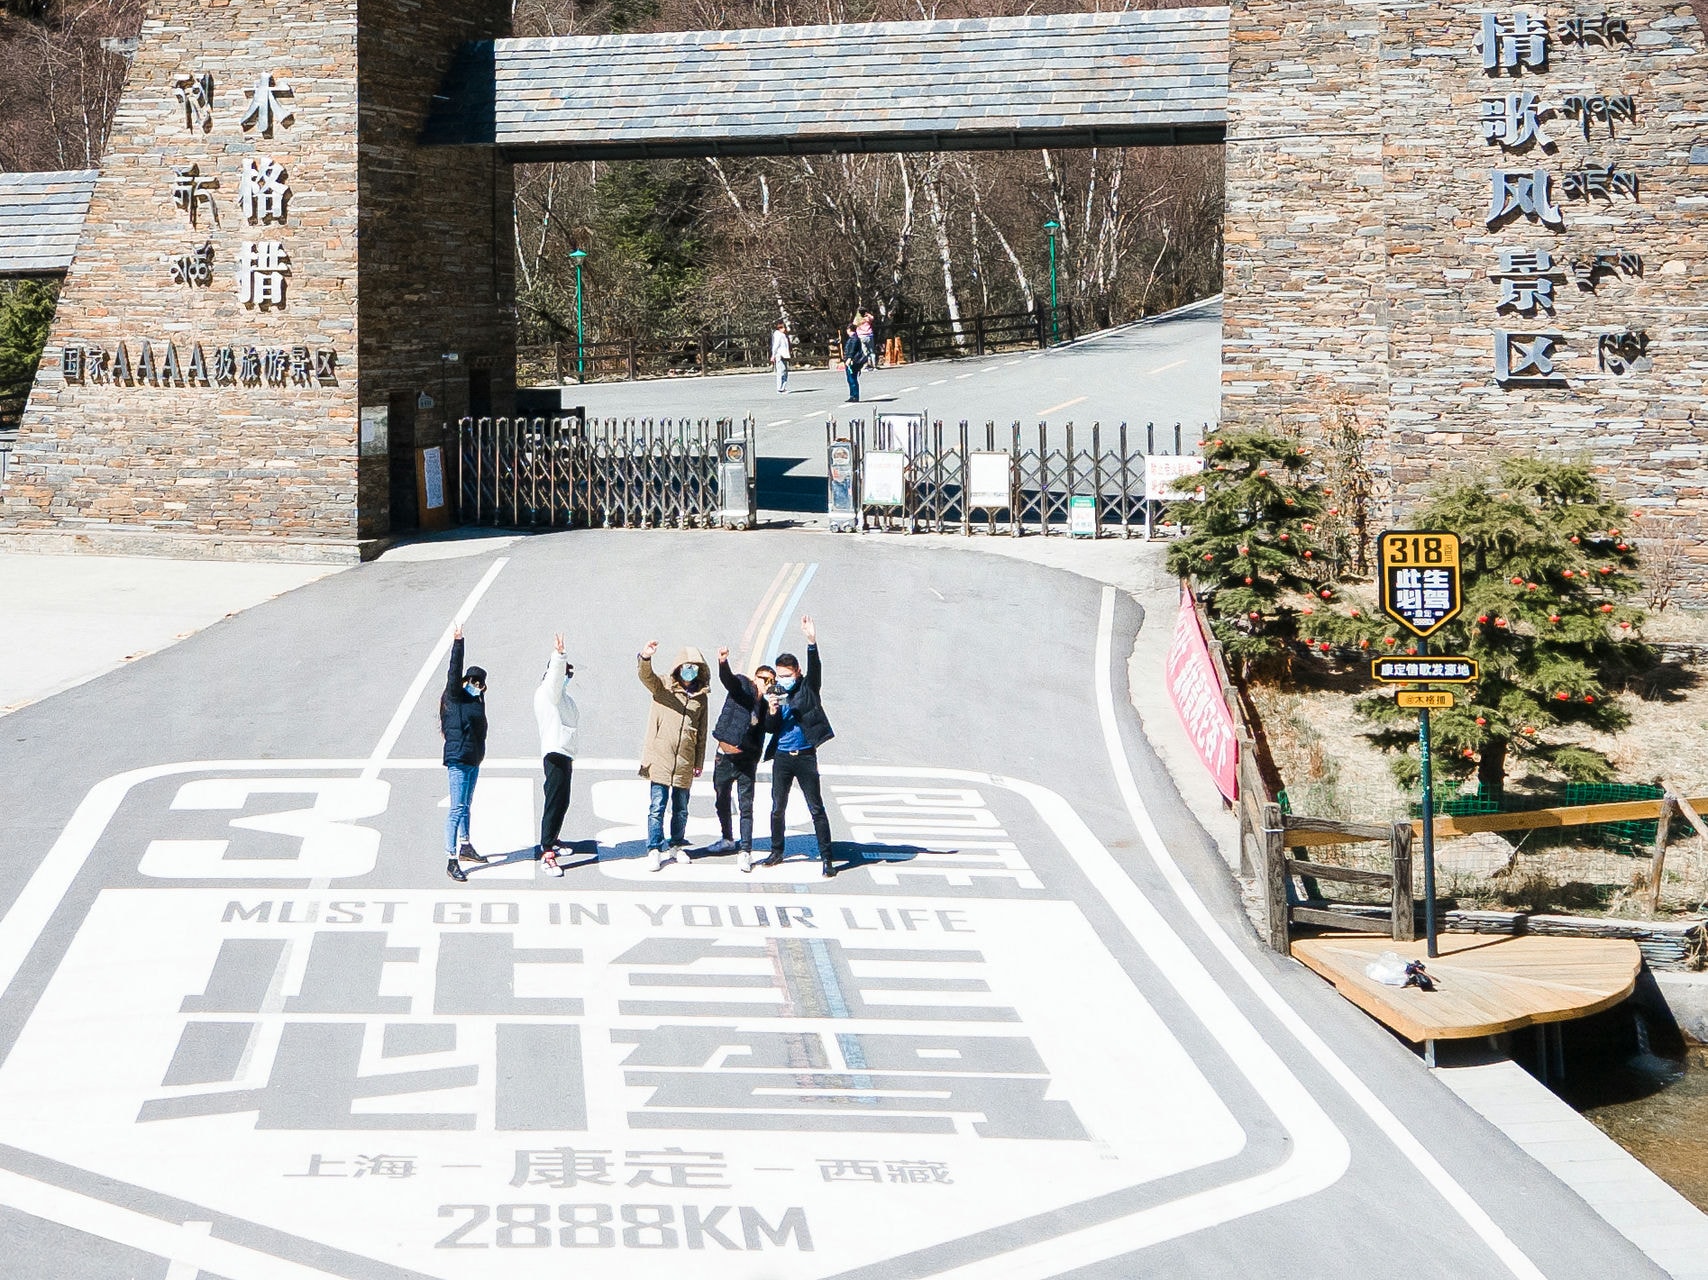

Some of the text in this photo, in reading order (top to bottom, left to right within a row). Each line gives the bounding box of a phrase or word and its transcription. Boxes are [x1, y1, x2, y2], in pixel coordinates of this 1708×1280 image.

[238, 71, 293, 307] 木格措
[62, 340, 337, 384] 国家AAAA级旅游景区
[1390, 538, 1442, 563] 318
[1396, 569, 1449, 588] 此生
[1396, 589, 1450, 609] 必驾
[1381, 664, 1470, 676] 康定情歌发源地
[137, 777, 836, 883] 318
[830, 785, 1046, 889] ROUTE
[220, 901, 977, 933] MUST GO IN YOUR LIFE
[178, 931, 1024, 1023] 此生
[433, 1203, 816, 1252] 2888KM
